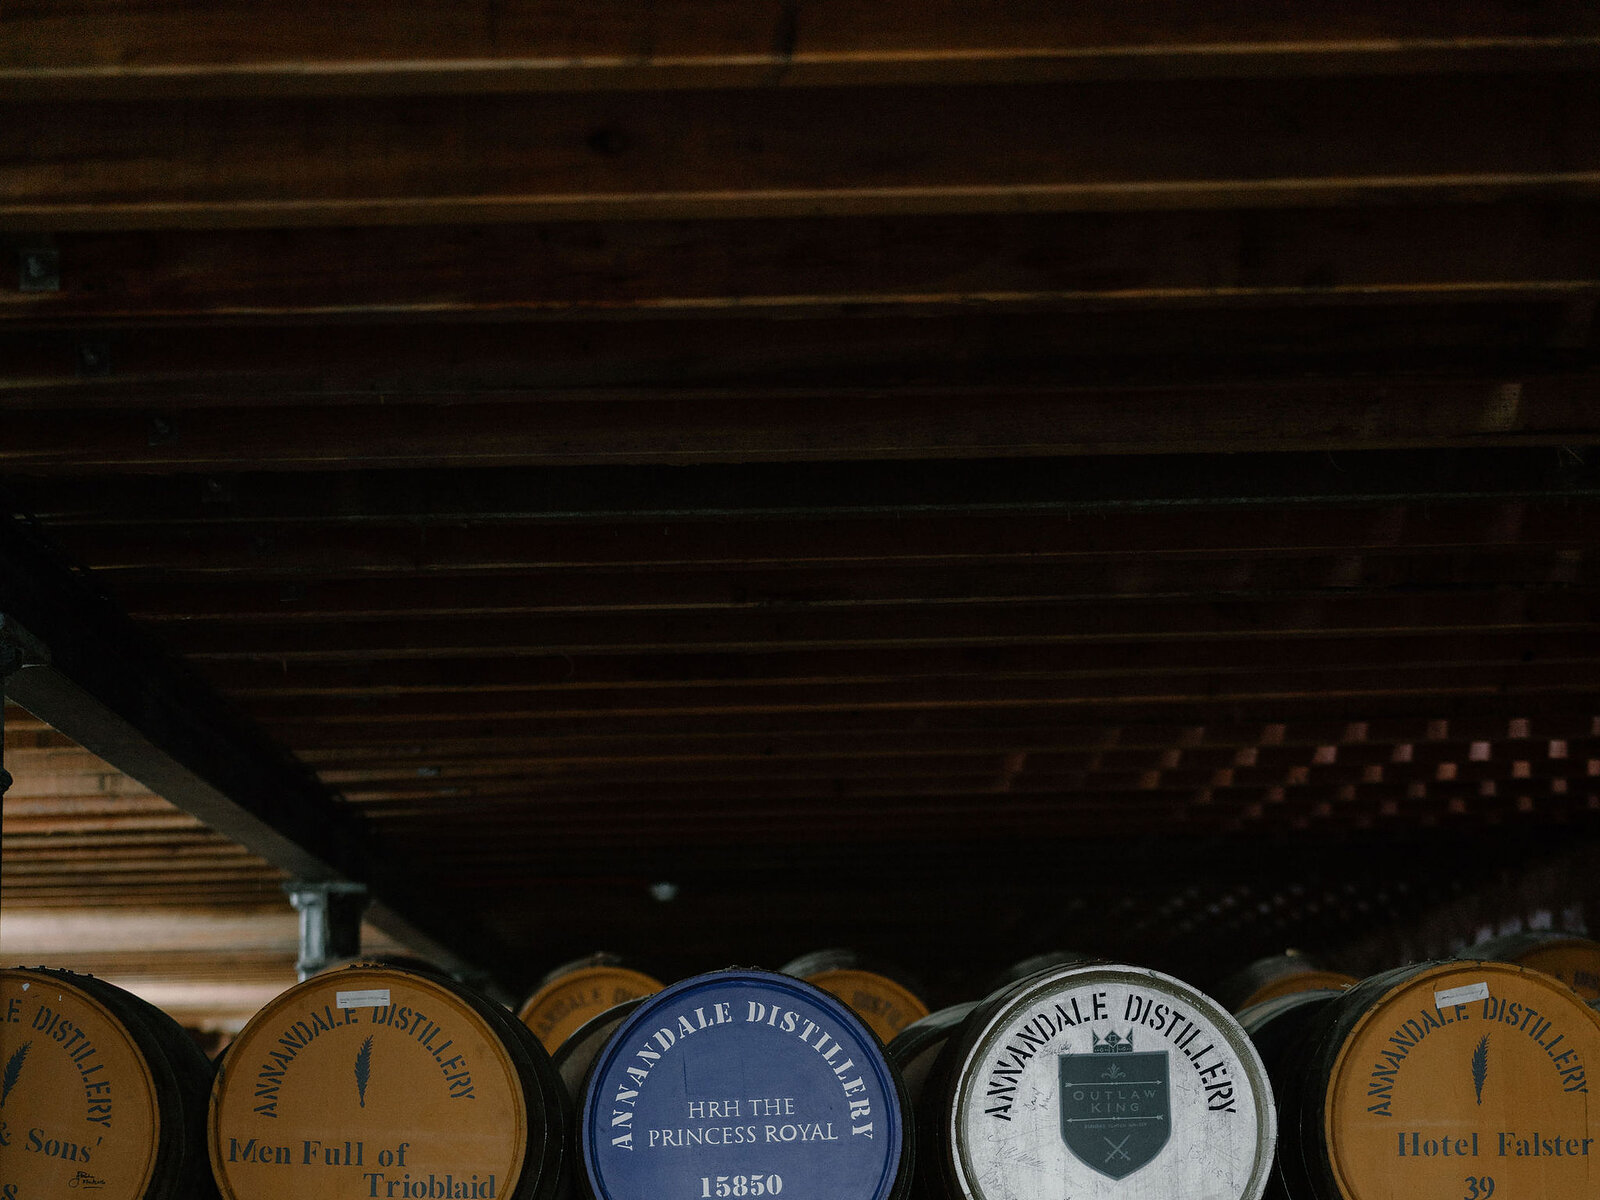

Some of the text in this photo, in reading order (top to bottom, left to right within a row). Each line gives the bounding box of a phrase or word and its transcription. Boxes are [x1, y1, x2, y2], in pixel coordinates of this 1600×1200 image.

[32, 1004, 112, 1128] DISTILLERY
[253, 1005, 359, 1118] ANNANDALE
[371, 1003, 476, 1101] DISTILLERY
[985, 993, 1237, 1121] ANNANDALE DISTILLERY
[1367, 997, 1589, 1117] ANNANDALE DISTILLERY
[611, 1001, 874, 1151] ANNANDALE DISTILLERY
[687, 1098, 796, 1120] HRH THE
[1073, 1090, 1157, 1101] OUTLAW
[1091, 1102, 1140, 1113] KING
[648, 1122, 839, 1148] PRINCESS ROYAL
[1397, 1131, 1595, 1157] Hotel Falster
[228, 1137, 410, 1168] Men Full of
[363, 1172, 497, 1200] Trioblaid
[700, 1174, 783, 1199] 15850
